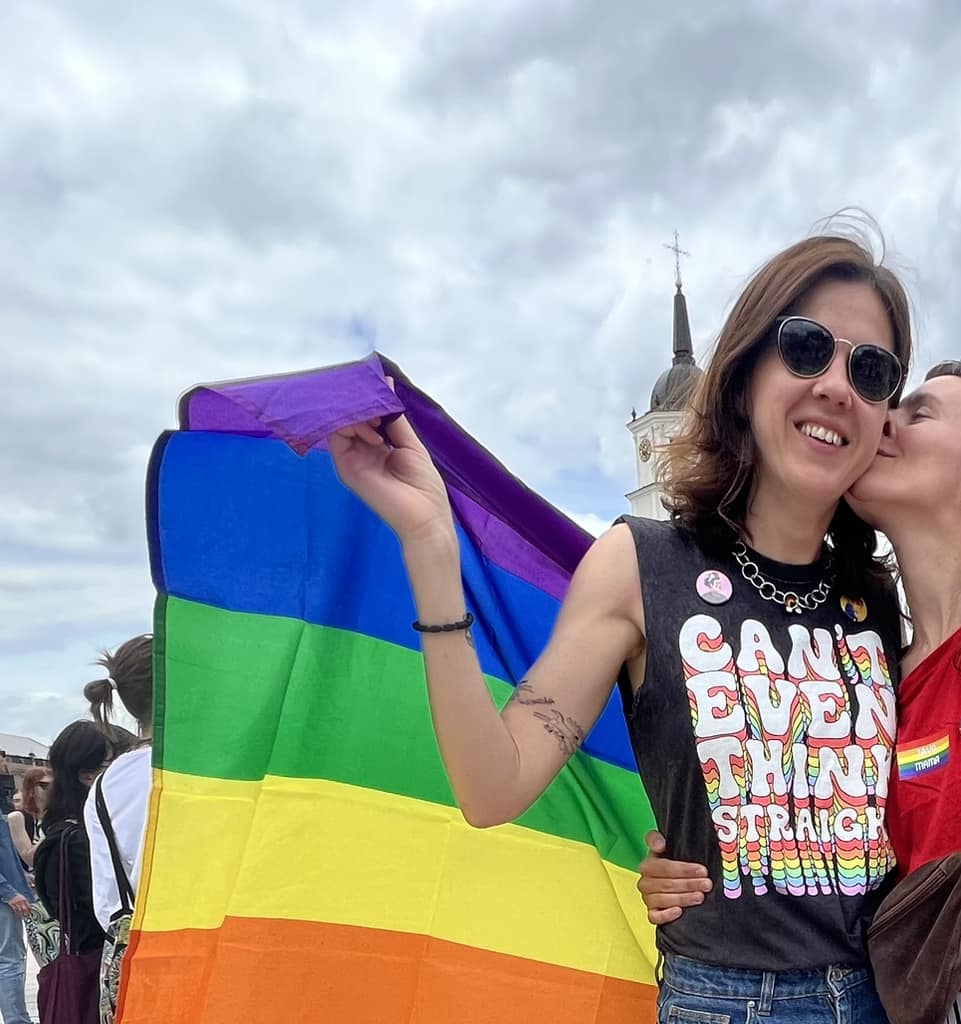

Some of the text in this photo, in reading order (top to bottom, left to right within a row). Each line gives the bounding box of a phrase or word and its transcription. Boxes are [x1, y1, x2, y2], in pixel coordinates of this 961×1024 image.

[679, 614, 889, 686] CAN'T
[685, 671, 897, 747] EVEN
[915, 755, 940, 772] MAMA
[711, 804, 888, 842] STRAIGH
